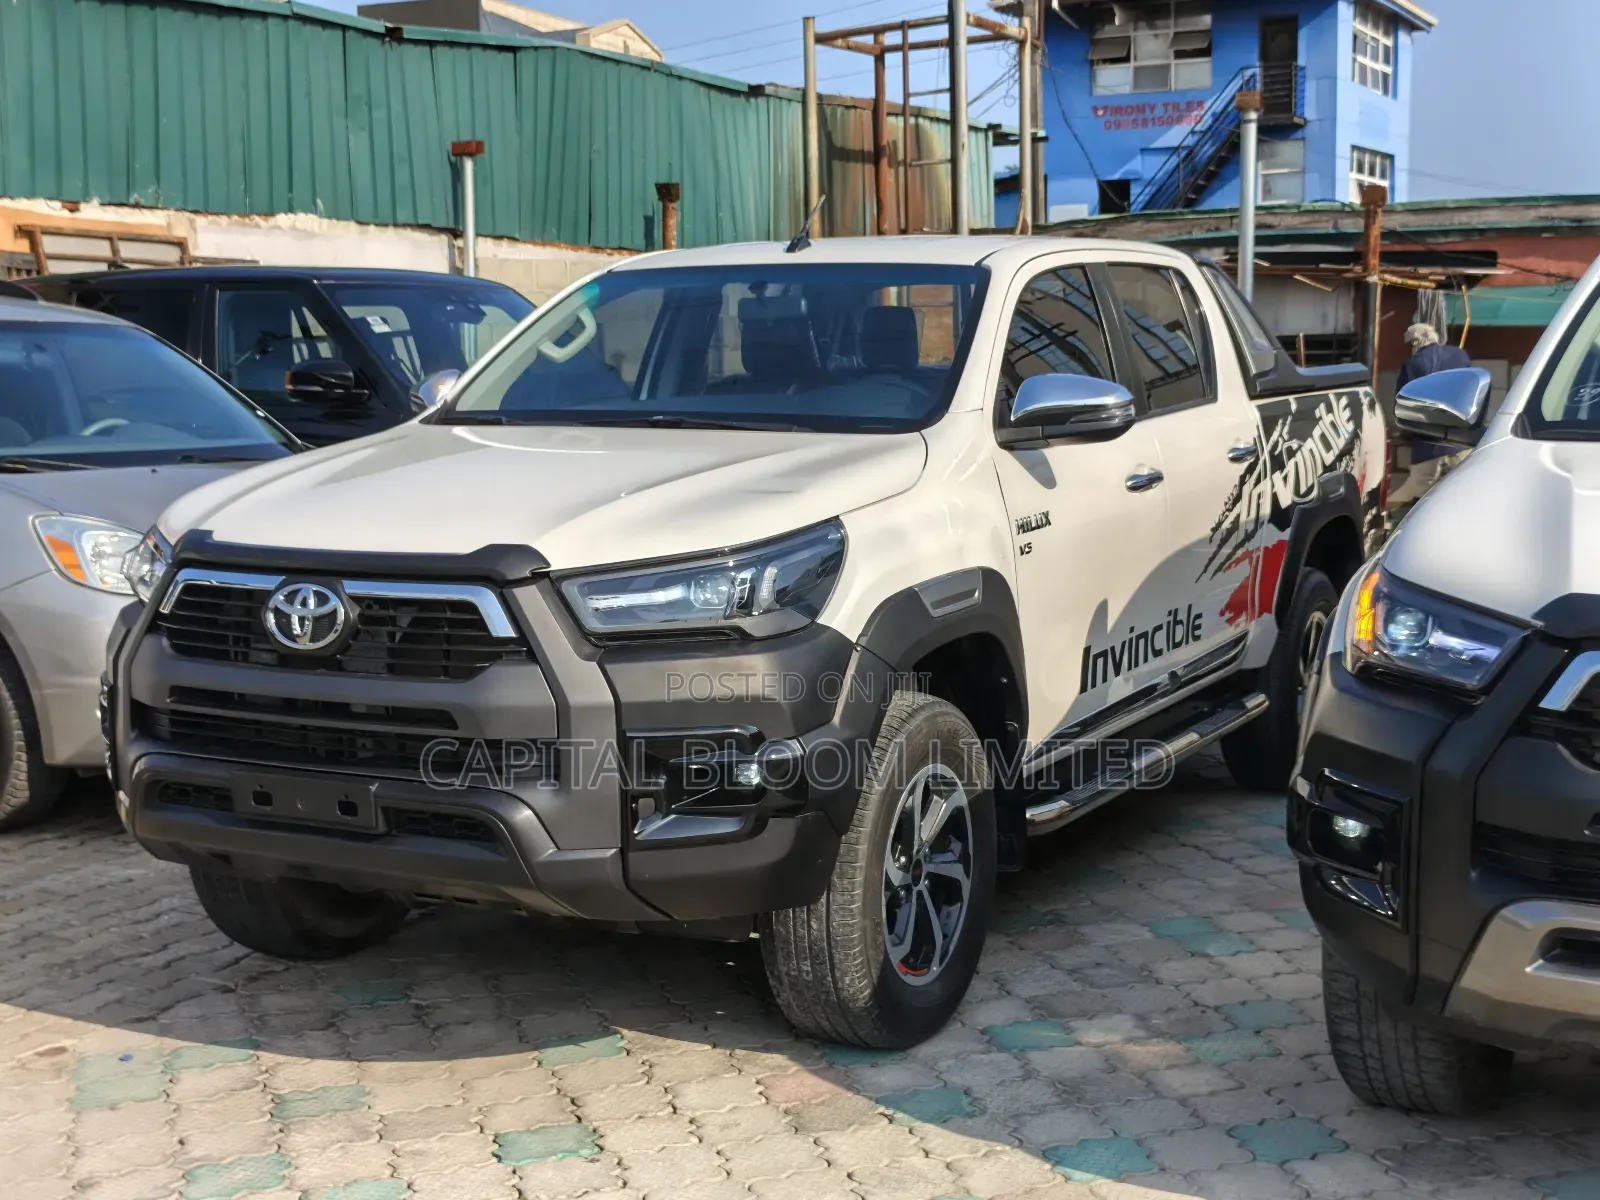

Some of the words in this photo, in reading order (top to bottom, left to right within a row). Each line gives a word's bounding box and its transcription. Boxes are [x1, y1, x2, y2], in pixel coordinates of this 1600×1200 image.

[1163, 101, 1206, 114] TILES
[1014, 510, 1052, 536] HILUX
[1079, 603, 1203, 695] Invincible
